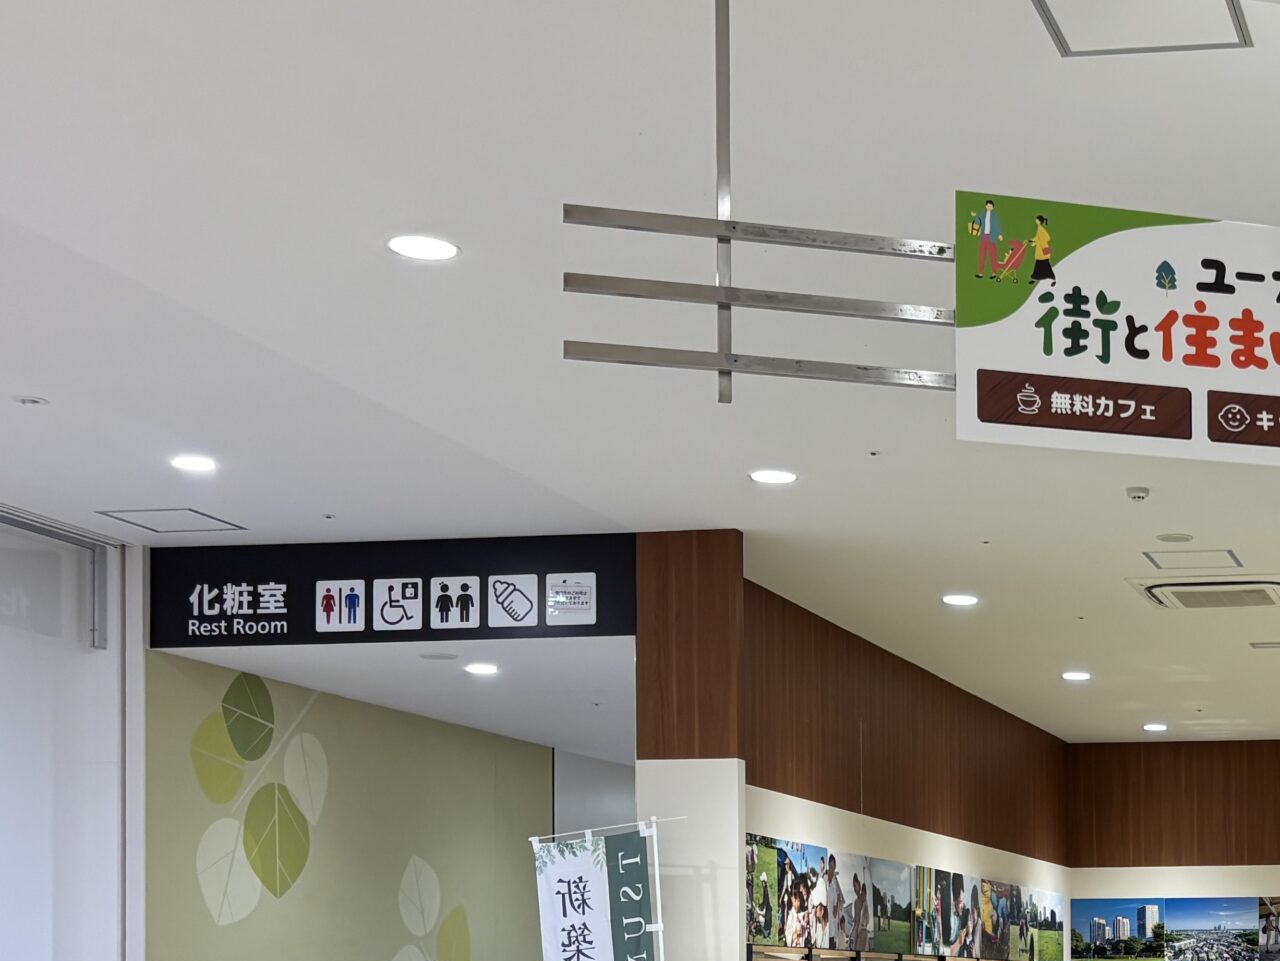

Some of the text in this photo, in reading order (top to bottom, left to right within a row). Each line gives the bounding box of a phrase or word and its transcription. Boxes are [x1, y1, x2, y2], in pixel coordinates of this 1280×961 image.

[1050, 390, 1157, 421] 無料カフェ
[188, 582, 288, 617] 化粧室
[188, 617, 288, 636] Rest Room
